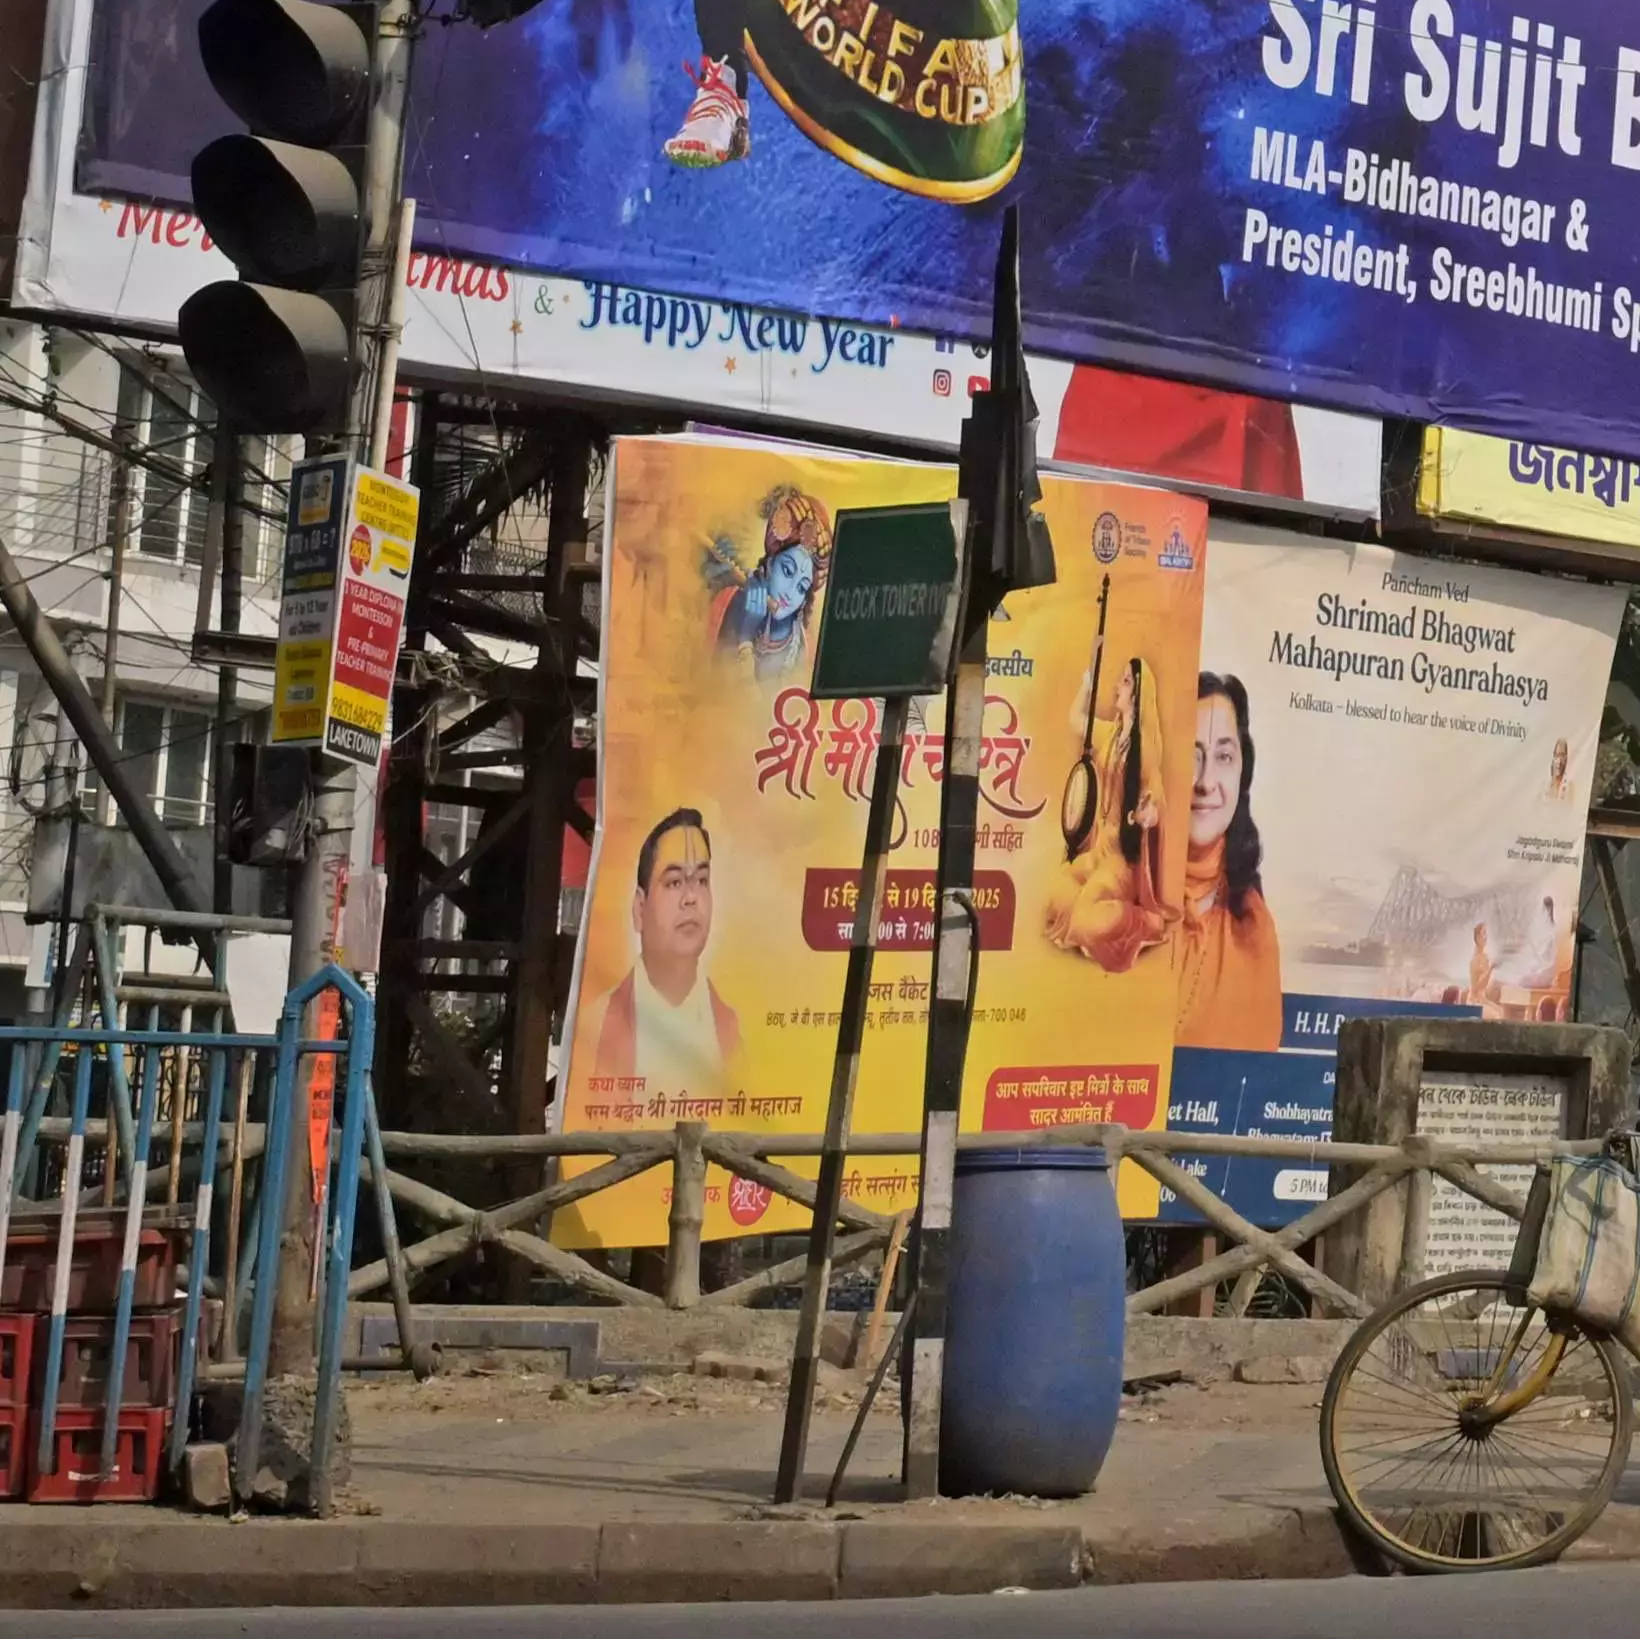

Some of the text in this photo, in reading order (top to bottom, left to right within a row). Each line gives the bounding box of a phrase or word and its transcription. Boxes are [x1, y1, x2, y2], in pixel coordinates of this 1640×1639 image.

[915, 75, 990, 124] CUP
[1249, 125, 1591, 252] MLA-Bidhannagar &
[1241, 207, 1417, 297] President,
[1430, 245, 1602, 333] Sreebhumi
[533, 284, 556, 317] &
[579, 277, 712, 350] Happy
[715, 302, 808, 355] New
[810, 314, 896, 373] Year
[834, 584, 880, 621] CLOCK
[881, 582, 928, 618] TOWER
[1445, 580, 1470, 603] Ved
[1315, 592, 1516, 654] Shrimad Bhagwat
[1268, 630, 1549, 707] Mahapuran Gyanrahasya
[1289, 690, 1529, 741] Kolkata blessed to hear the voice of Divinity
[328, 722, 380, 758] LAKETOWN
[823, 886, 839, 910] 15
[903, 888, 920, 910] 19
[1294, 1010, 1309, 1034] H.
[1313, 1012, 1331, 1036] H.
[995, 1079, 1019, 1099] आप
[1021, 1075, 1068, 1098] सपरिवार
[1112, 1073, 1125, 1097] के
[648, 1091, 667, 1120] श्री
[727, 1090, 746, 1118] जी
[749, 1095, 803, 1122] महाराज
[1184, 1100, 1220, 1127] Hall,
[1299, 1177, 1317, 1194] PM
